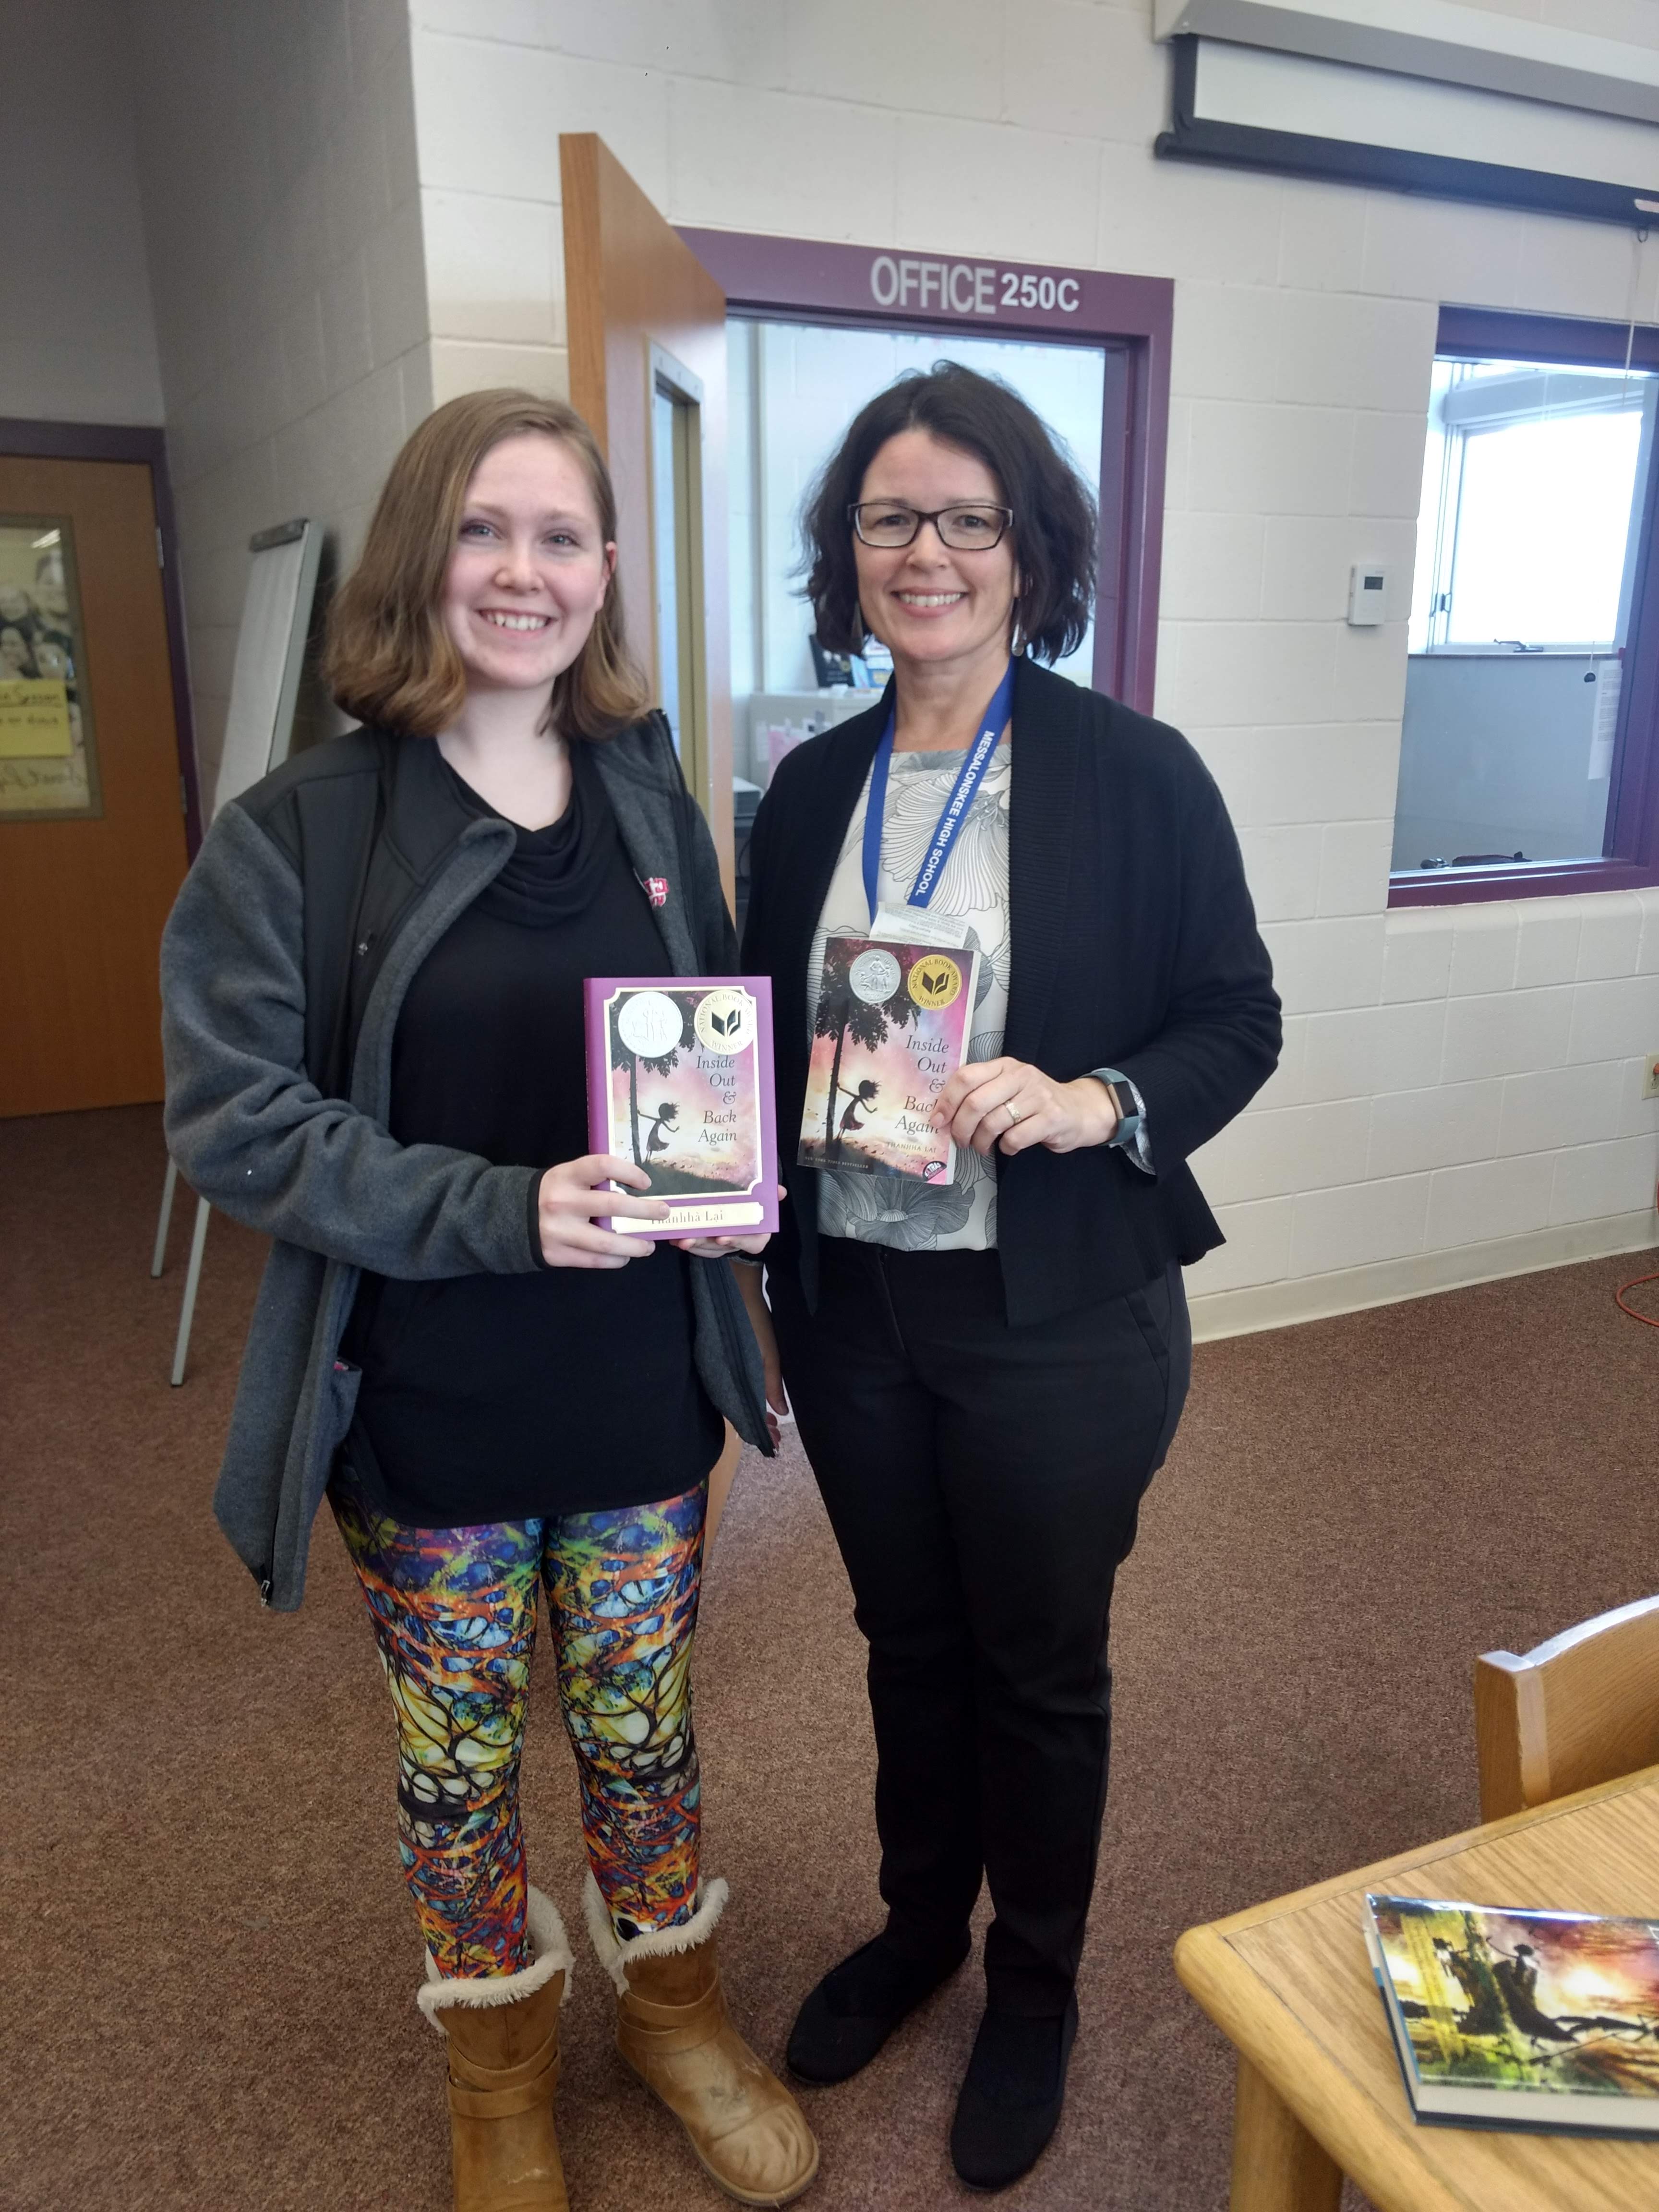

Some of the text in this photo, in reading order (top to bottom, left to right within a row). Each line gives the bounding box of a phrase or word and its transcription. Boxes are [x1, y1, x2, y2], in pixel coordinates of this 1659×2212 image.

[870, 256, 1080, 314] OFFICE 250C
[915, 730, 995, 897] MESSALONSKEE HIGH SCHOOL
[913, 960, 933, 989] NATIONAL
[935, 959, 952, 971] BOOK
[919, 996, 945, 1006] WINNER
[699, 996, 720, 1033] NATIONAL
[722, 994, 743, 1007] BOOK
[711, 1040, 744, 1051] WINNER
[905, 1034, 949, 1053] Inside
[696, 1055, 735, 1069] Inside
[917, 1057, 947, 1073] Out
[709, 1073, 735, 1087] Out
[929, 1078, 946, 1094] &
[723, 1091, 737, 1105] &
[703, 1109, 737, 1124] Back
[698, 1129, 737, 1146] Again
